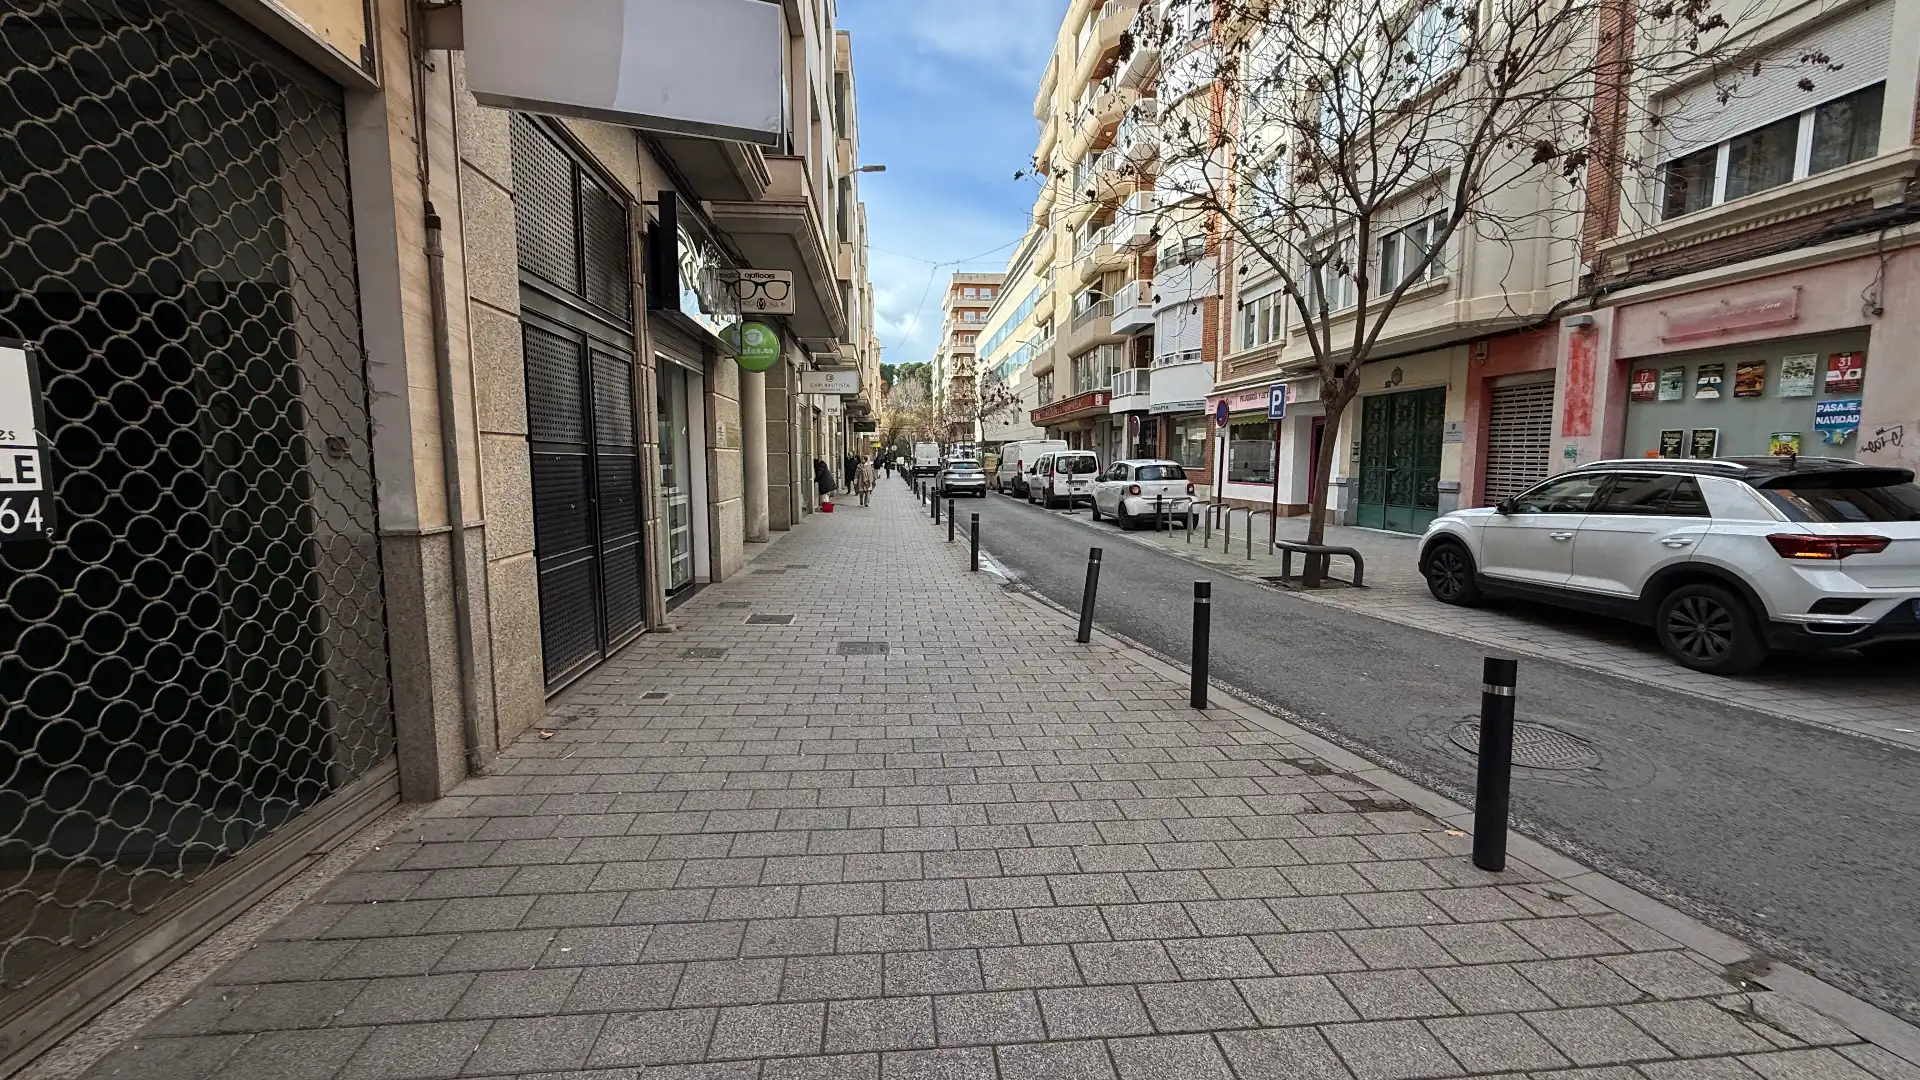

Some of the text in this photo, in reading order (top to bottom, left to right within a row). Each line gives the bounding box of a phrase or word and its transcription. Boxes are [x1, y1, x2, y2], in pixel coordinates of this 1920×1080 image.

[1838, 357, 1852, 367] 31
[1641, 372, 1649, 381] 17
[1271, 389, 1283, 416] P
[1816, 402, 1858, 413] PASAJE
[1815, 414, 1860, 425] NAVIDAD
